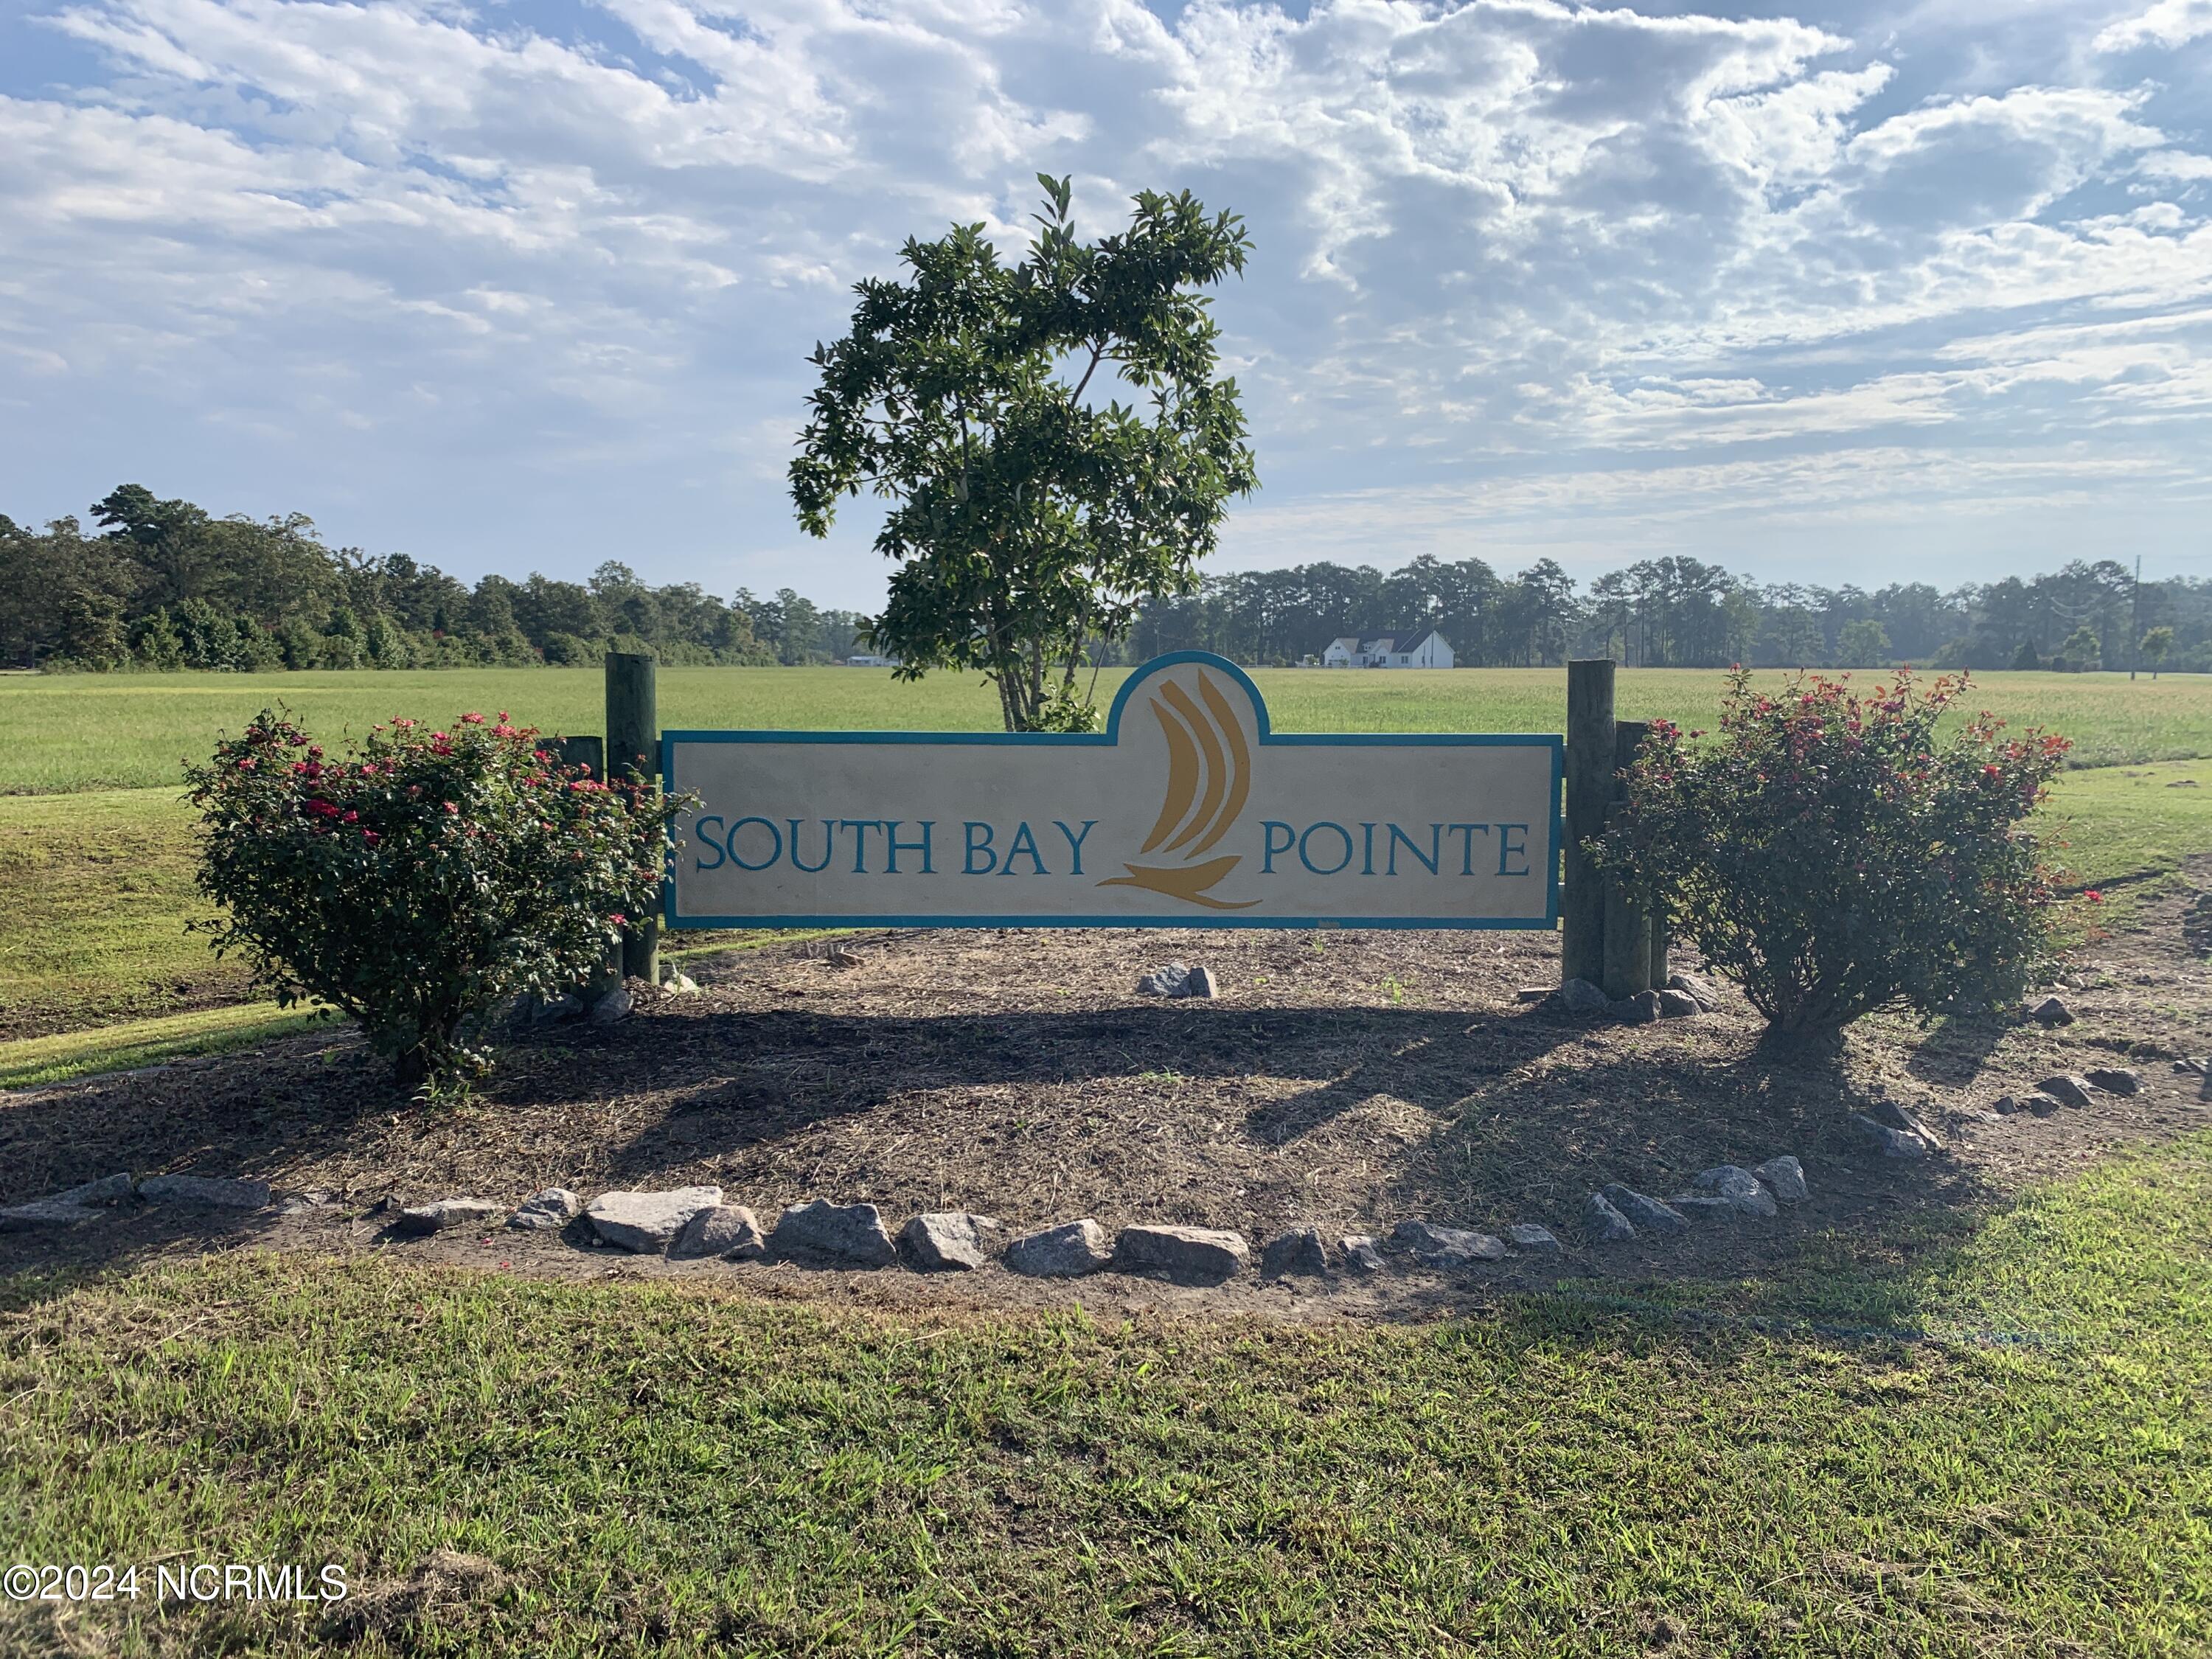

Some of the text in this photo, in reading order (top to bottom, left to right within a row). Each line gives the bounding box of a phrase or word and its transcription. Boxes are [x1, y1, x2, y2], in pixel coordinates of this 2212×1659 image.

[695, 815, 1531, 877] SOUTH BAY POINTE
